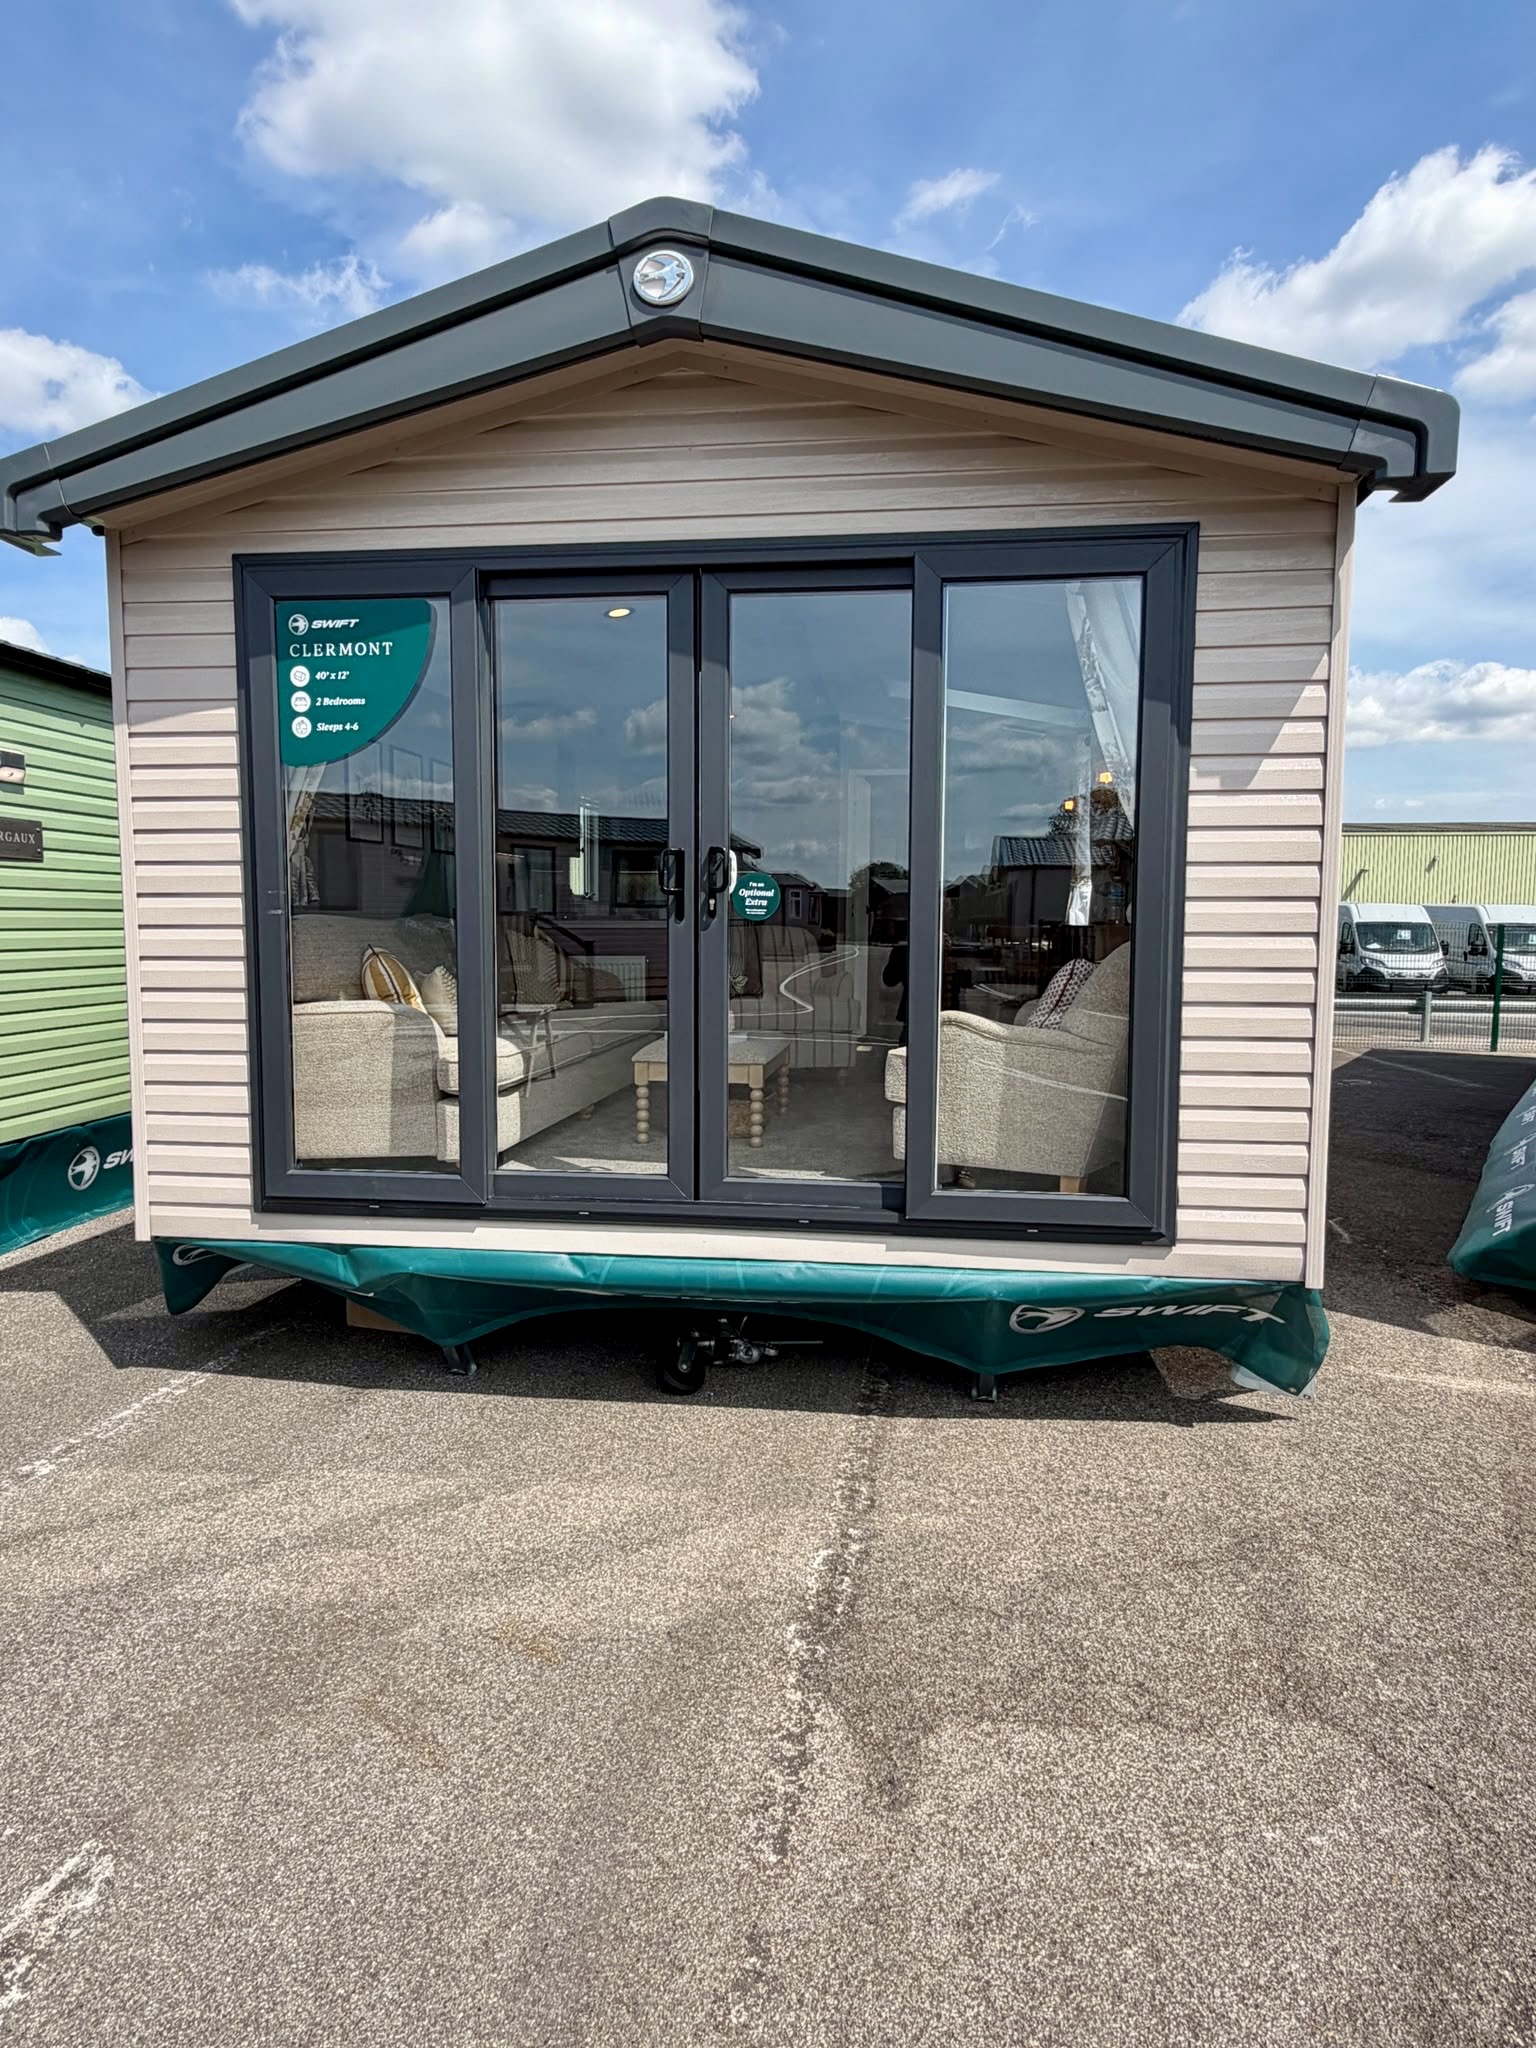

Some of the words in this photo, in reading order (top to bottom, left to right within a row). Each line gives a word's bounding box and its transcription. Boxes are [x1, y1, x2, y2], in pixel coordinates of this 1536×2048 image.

[311, 619, 359, 629] SWIFT
[289, 642, 393, 657] CLERMONT
[316, 697, 321, 706] 2
[323, 697, 366, 706] Bedrooms
[316, 722, 343, 732] Sleeps
[344, 722, 359, 731] 4-6
[739, 888, 774, 898] Optional
[745, 898, 768, 906] Extra
[1492, 1200, 1514, 1236] SWIFT
[1094, 1304, 1286, 1324] SWIFT
